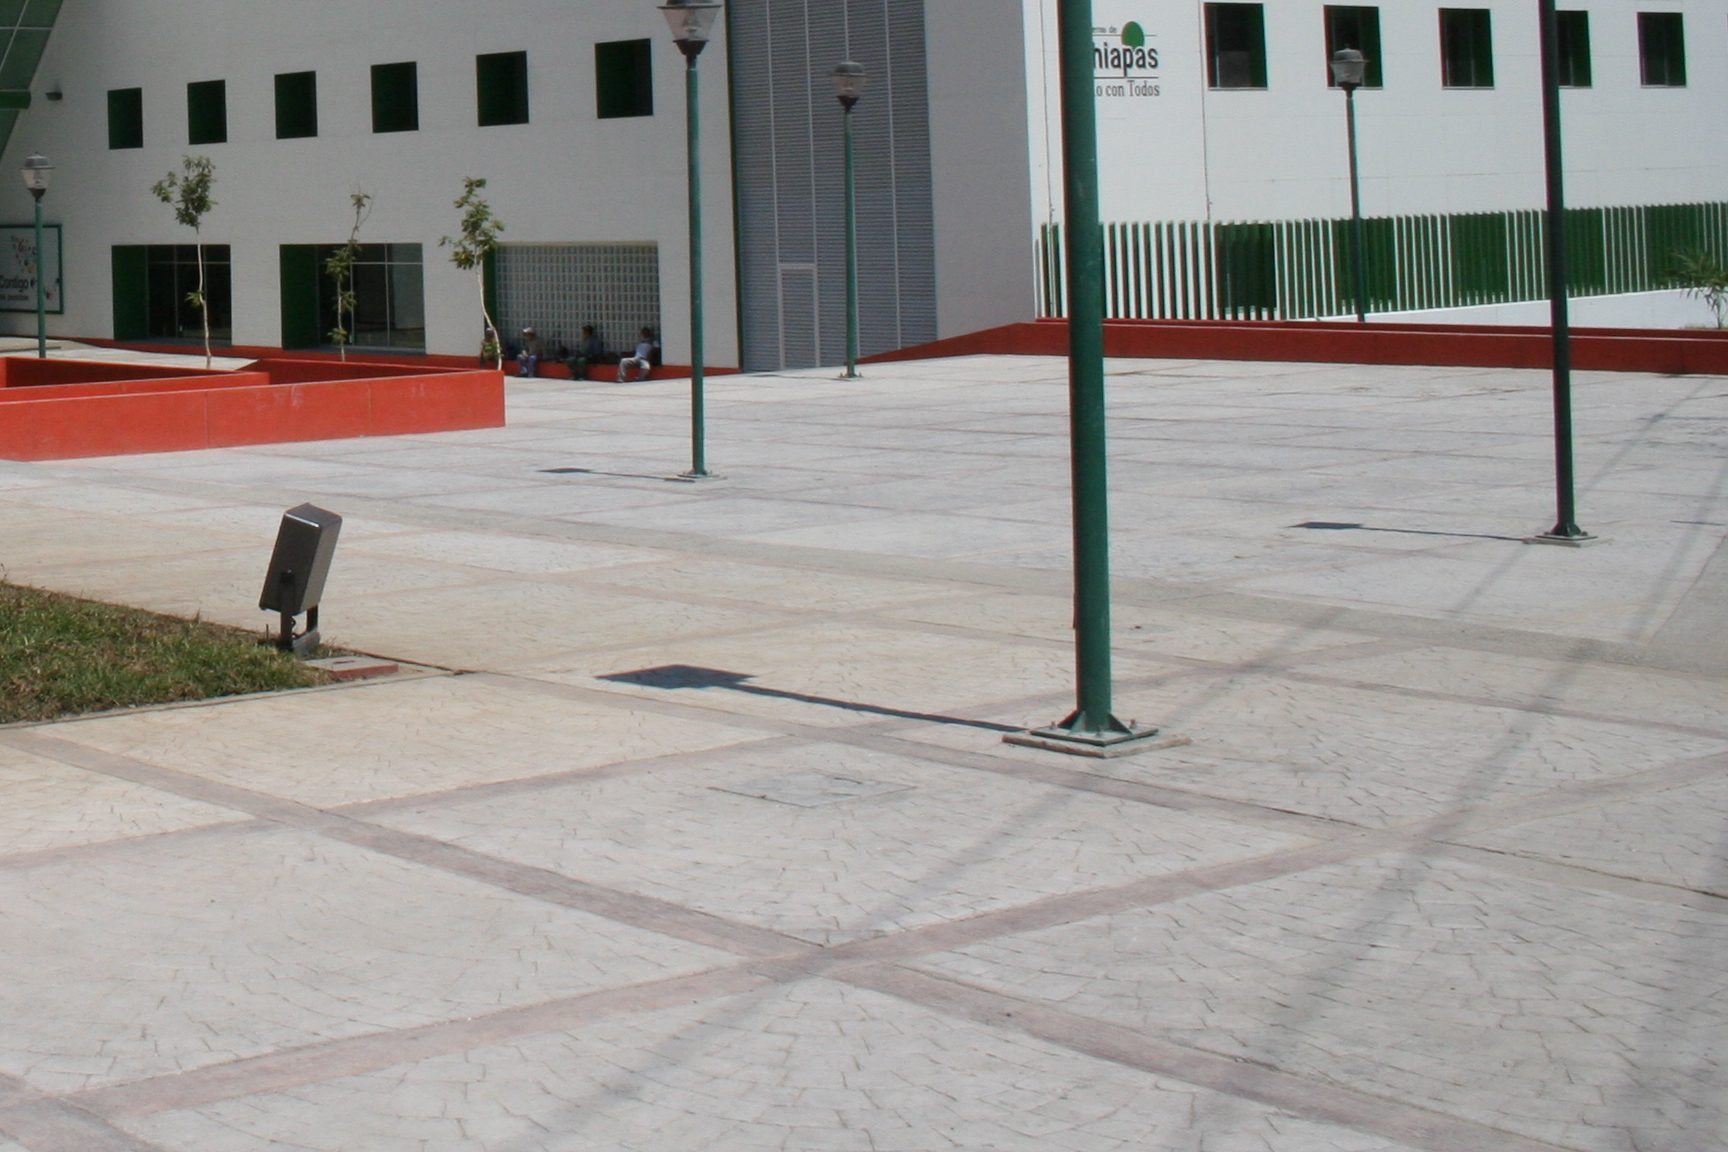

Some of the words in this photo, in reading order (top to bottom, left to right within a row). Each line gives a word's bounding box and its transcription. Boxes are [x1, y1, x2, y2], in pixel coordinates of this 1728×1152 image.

[1092, 41, 1159, 78] hiapas
[1105, 84, 1125, 97] con
[1127, 79, 1160, 97] Todos
